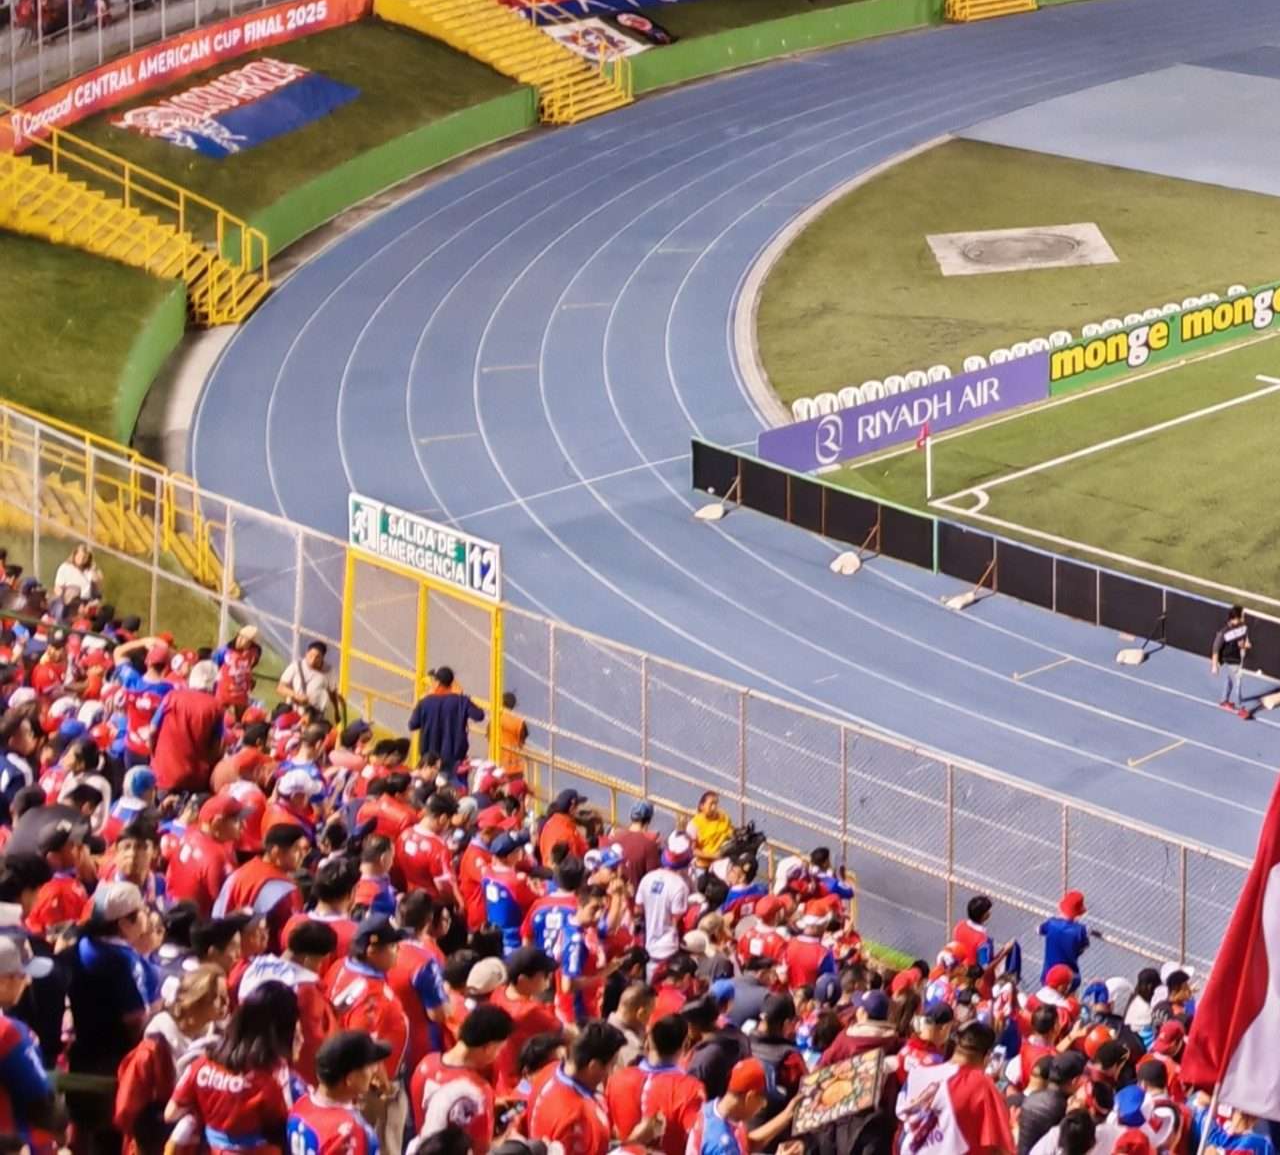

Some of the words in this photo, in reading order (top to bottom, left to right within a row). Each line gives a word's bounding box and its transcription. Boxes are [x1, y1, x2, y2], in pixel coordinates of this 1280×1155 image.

[23, 89, 74, 136] Concacaf
[74, 64, 136, 107] CENTRAL
[138, 36, 211, 81] AMERICAN
[213, 27, 241, 53] CUP
[243, 14, 284, 44] FINAL
[286, 0, 327, 30] 2025
[1050, 319, 1169, 382] monge
[857, 390, 952, 443] RIYADH
[958, 377, 1000, 413] AIR
[380, 534, 465, 584] EMERGENCIA
[387, 515, 436, 550] SALIDA
[437, 531, 458, 557] DE
[469, 545, 497, 592] 12
[197, 1065, 243, 1093] Claro
